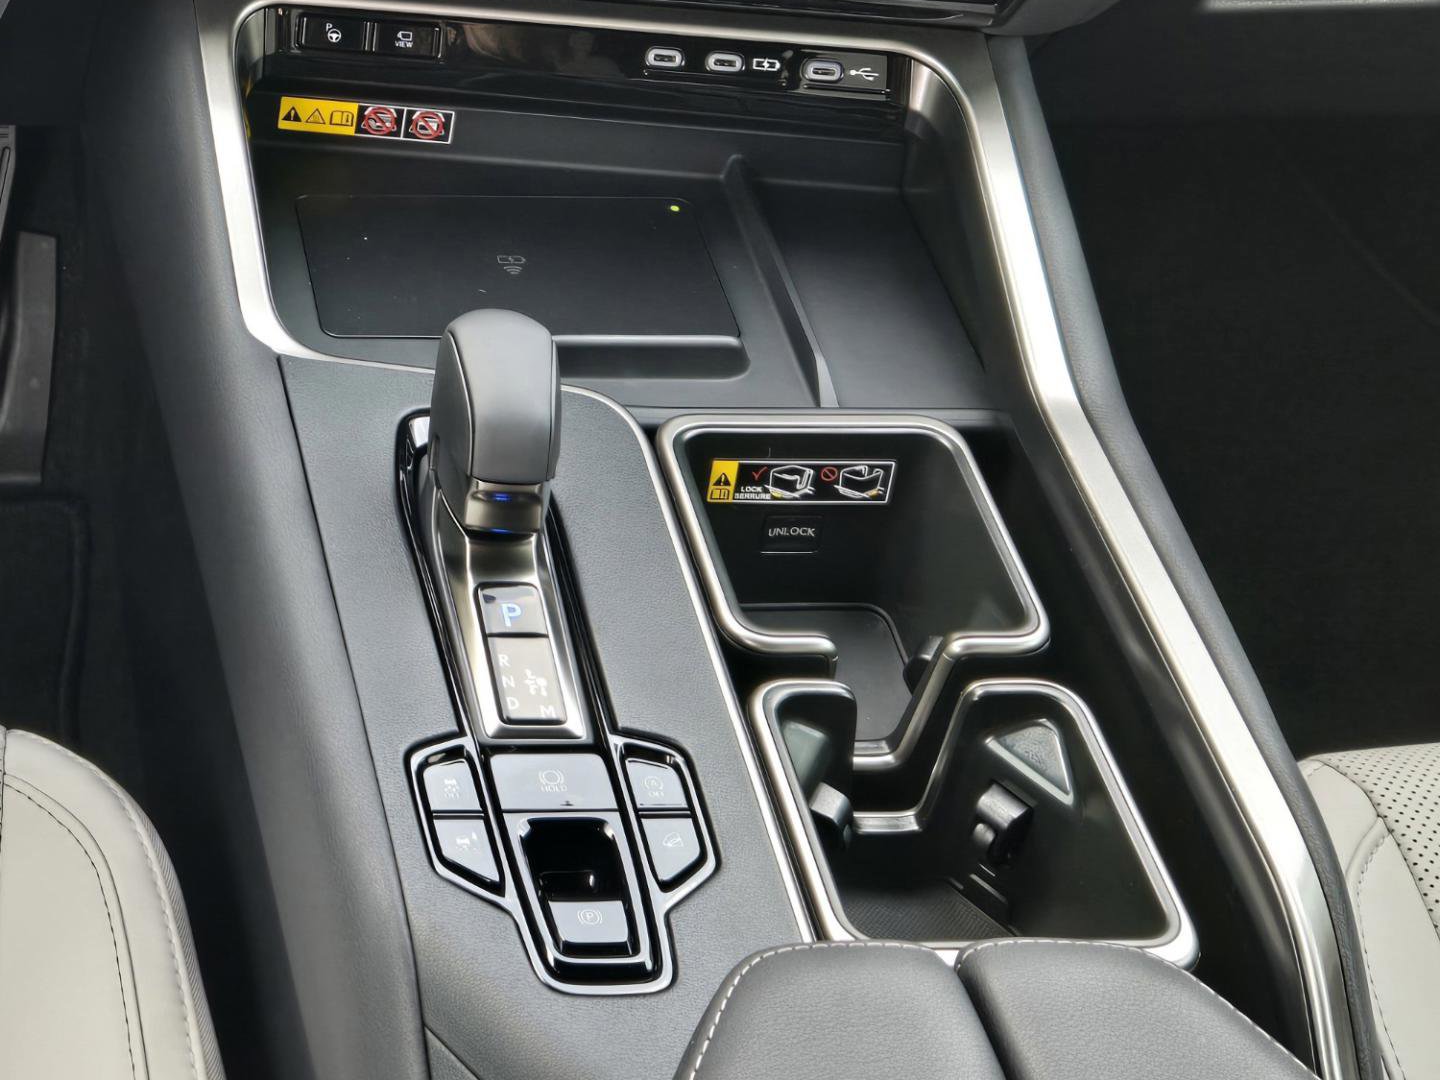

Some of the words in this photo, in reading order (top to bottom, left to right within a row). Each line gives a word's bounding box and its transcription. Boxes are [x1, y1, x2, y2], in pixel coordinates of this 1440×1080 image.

[326, 23, 333, 31] P
[394, 40, 414, 48] VIEW
[768, 526, 816, 536] UNLOCK
[502, 603, 522, 627] P
[498, 654, 510, 668] R
[502, 675, 516, 688] N
[506, 696, 519, 710] D
[540, 705, 557, 718] M
[540, 784, 568, 793] HOLD
